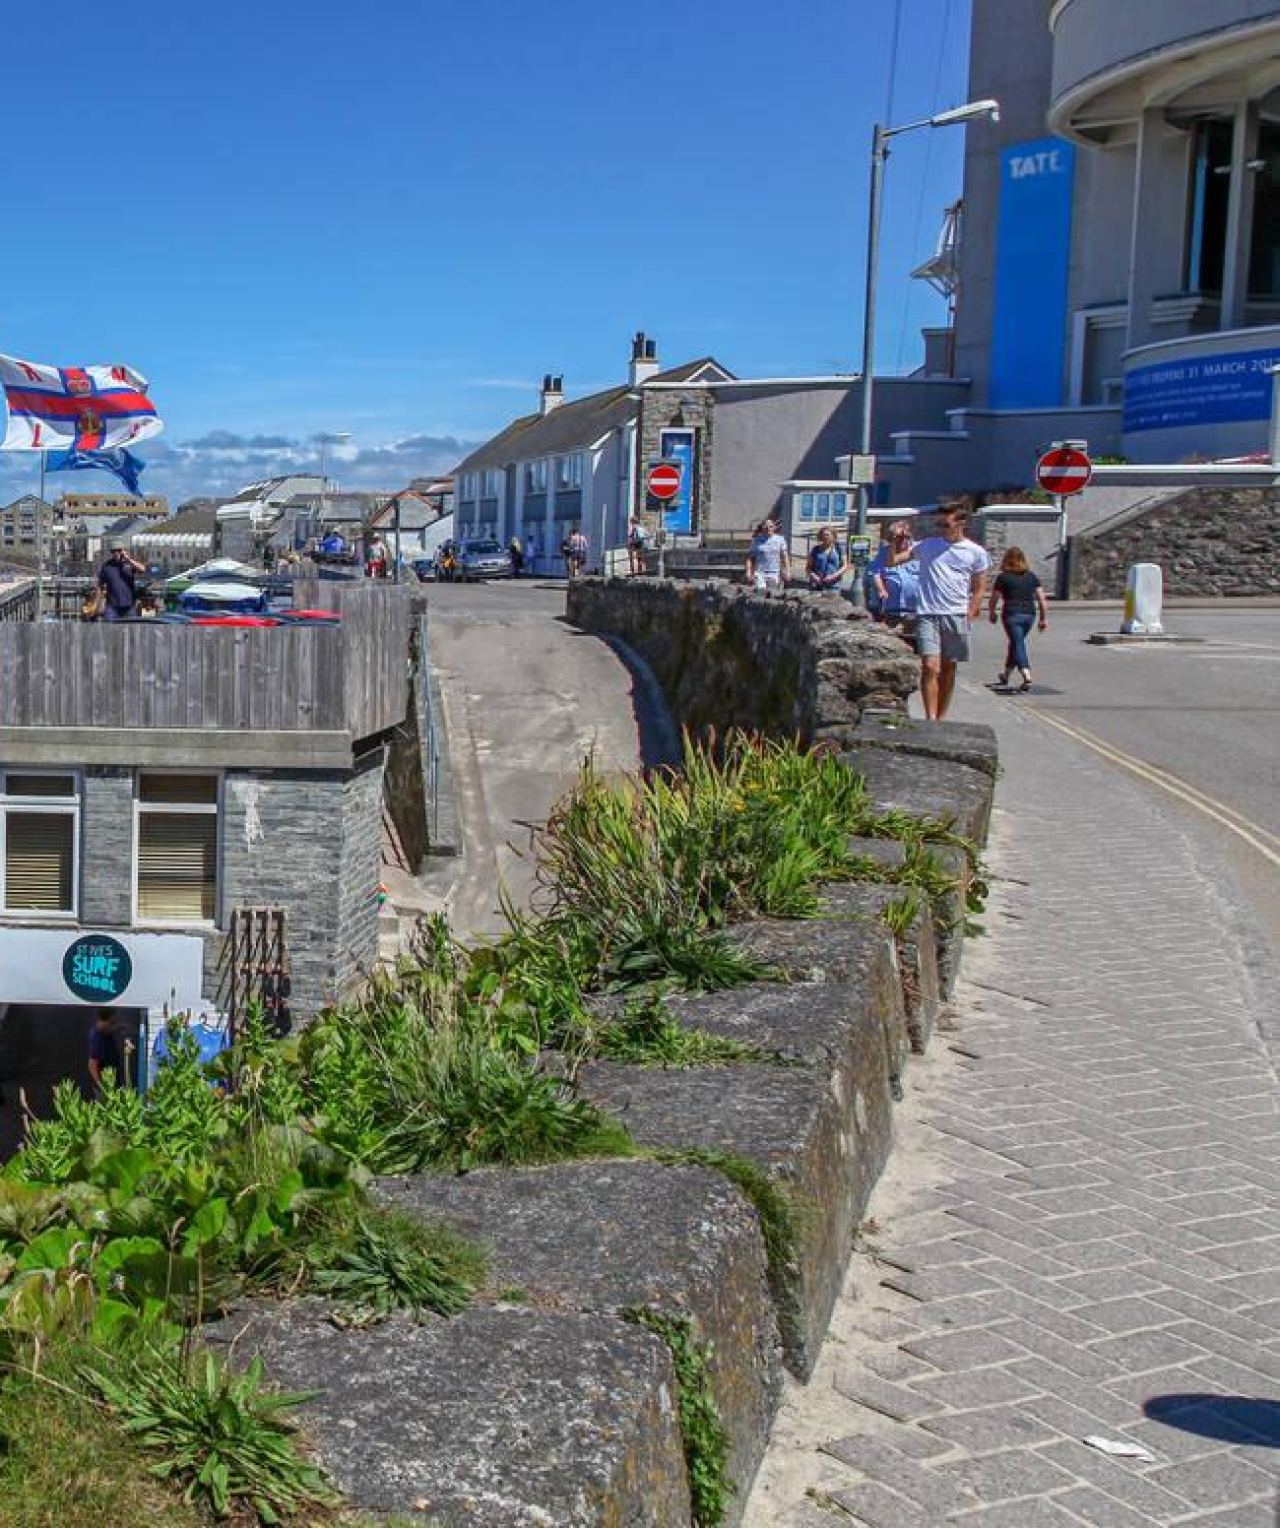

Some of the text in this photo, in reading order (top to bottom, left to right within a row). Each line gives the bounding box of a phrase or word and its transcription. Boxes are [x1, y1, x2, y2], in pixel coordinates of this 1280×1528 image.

[1009, 150, 1062, 179] TATE
[1204, 361, 1246, 376] MARCH
[73, 955, 120, 977] SURF
[72, 972, 117, 993] SCHOOL
